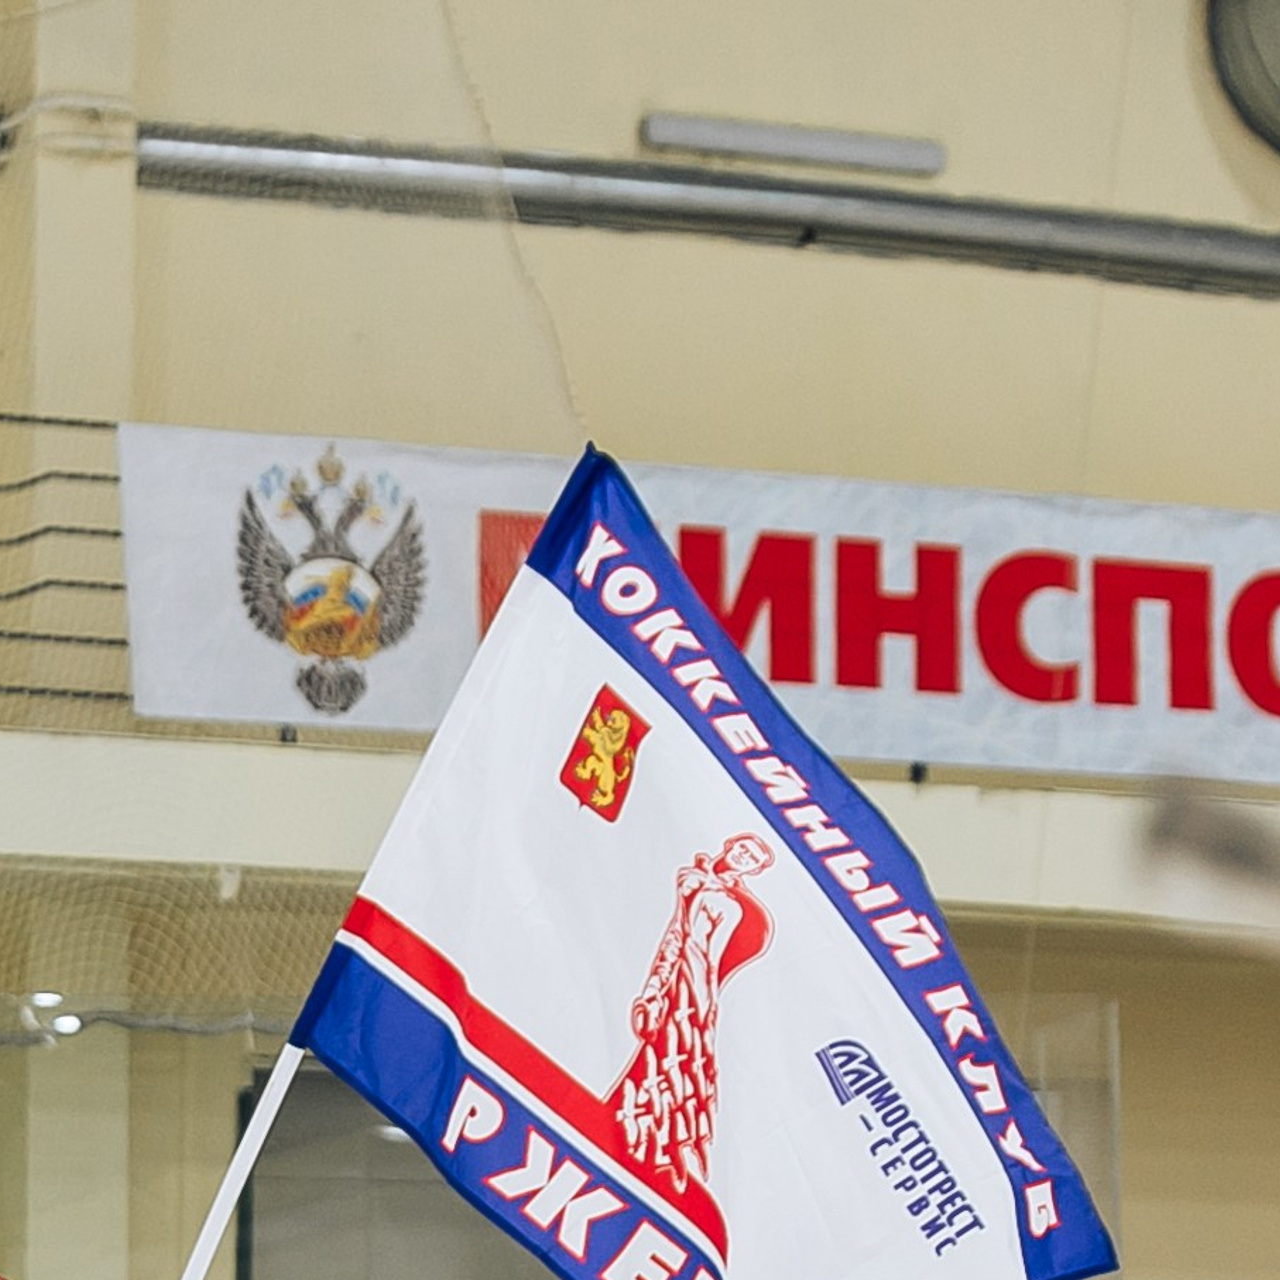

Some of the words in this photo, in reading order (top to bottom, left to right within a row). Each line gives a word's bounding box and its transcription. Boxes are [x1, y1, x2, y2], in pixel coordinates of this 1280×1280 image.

[574, 520, 943, 968] ХОККЕЙНЫЙ
[922, 981, 1062, 1240] КЛУБ
[865, 1080, 985, 1239] МОСТОТРЕСТ
